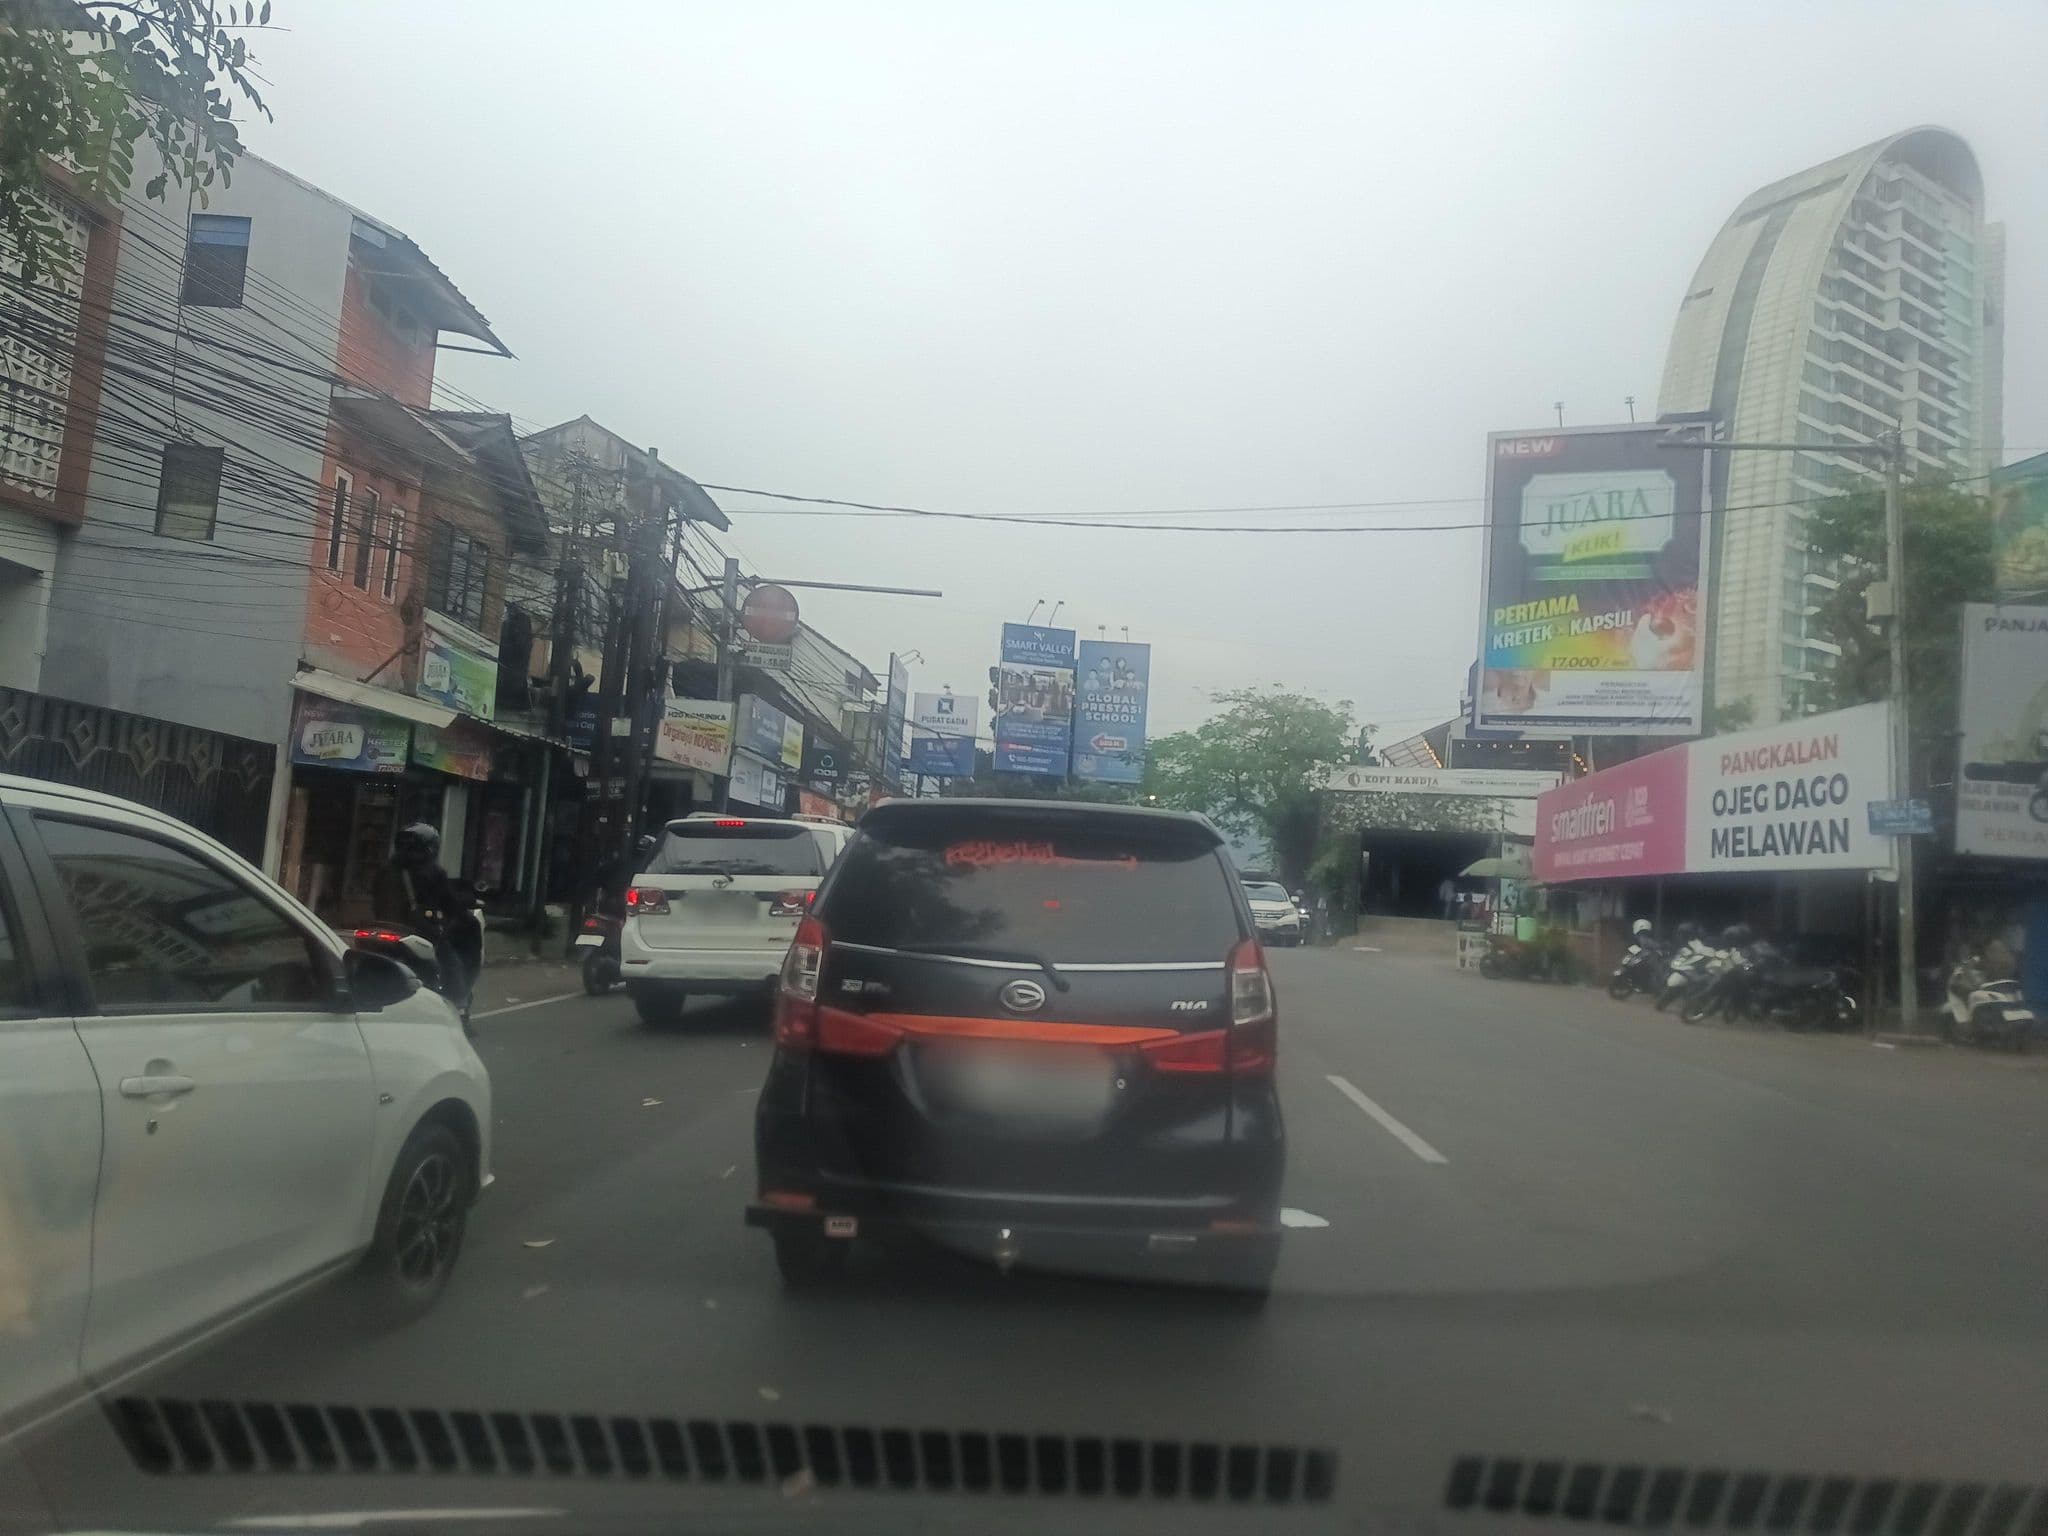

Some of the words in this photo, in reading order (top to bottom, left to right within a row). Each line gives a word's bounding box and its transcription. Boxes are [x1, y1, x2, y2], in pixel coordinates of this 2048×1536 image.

[1498, 438, 1555, 457] NEW
[1539, 486, 1652, 538] JUARA
[1493, 593, 1581, 626] PERTAMA
[1492, 624, 1554, 651] KRETEK
[1569, 609, 1635, 637] KAPSUL
[1006, 639, 1039, 652] SMART
[1039, 642, 1073, 656] VALLEY
[1081, 703, 1142, 714] PRESTASI
[1087, 693, 1137, 705] GLOBAL
[1086, 713, 1137, 724] SCHOOL
[1720, 734, 1840, 777] PANGKALAN
[1364, 774, 1391, 785] KOPI
[1394, 775, 1440, 788] MANDJA
[1711, 779, 1769, 819] OJEG
[1773, 771, 1849, 812] DAGO
[1551, 791, 1617, 843] smartfren
[1710, 817, 1850, 860] MELAWAN
